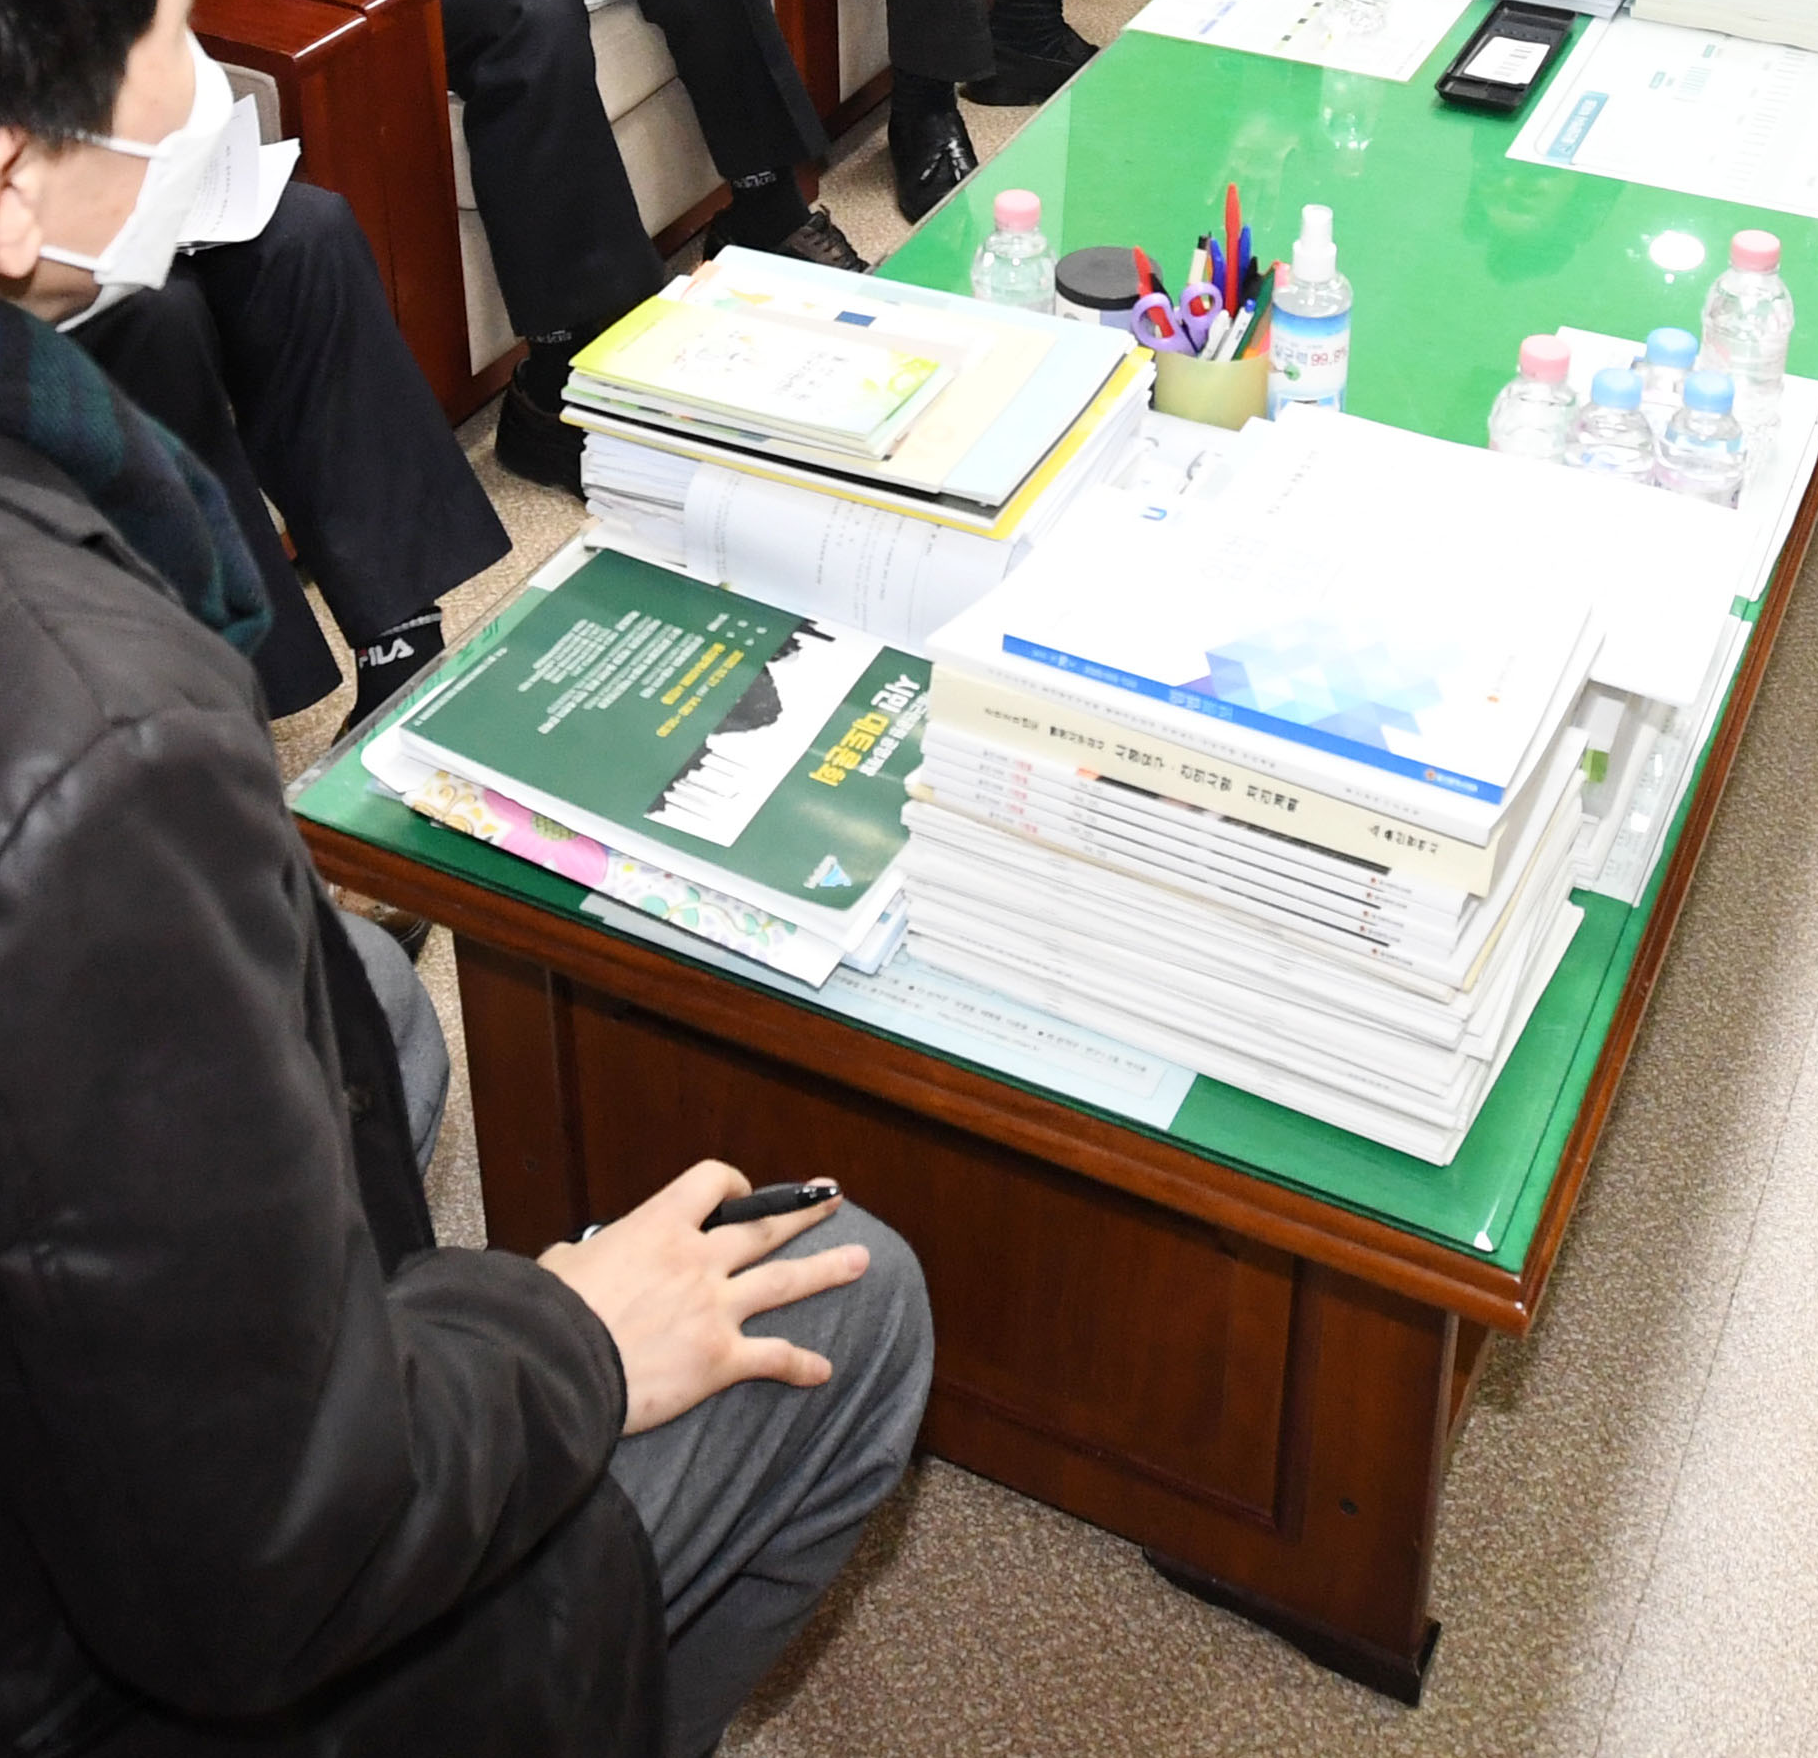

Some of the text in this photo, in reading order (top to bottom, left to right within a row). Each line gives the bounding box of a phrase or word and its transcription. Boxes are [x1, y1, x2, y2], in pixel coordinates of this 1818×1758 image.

[359, 637, 415, 669] FILA
[870, 674, 921, 714] 시민
[808, 711, 890, 787] 대토론회
